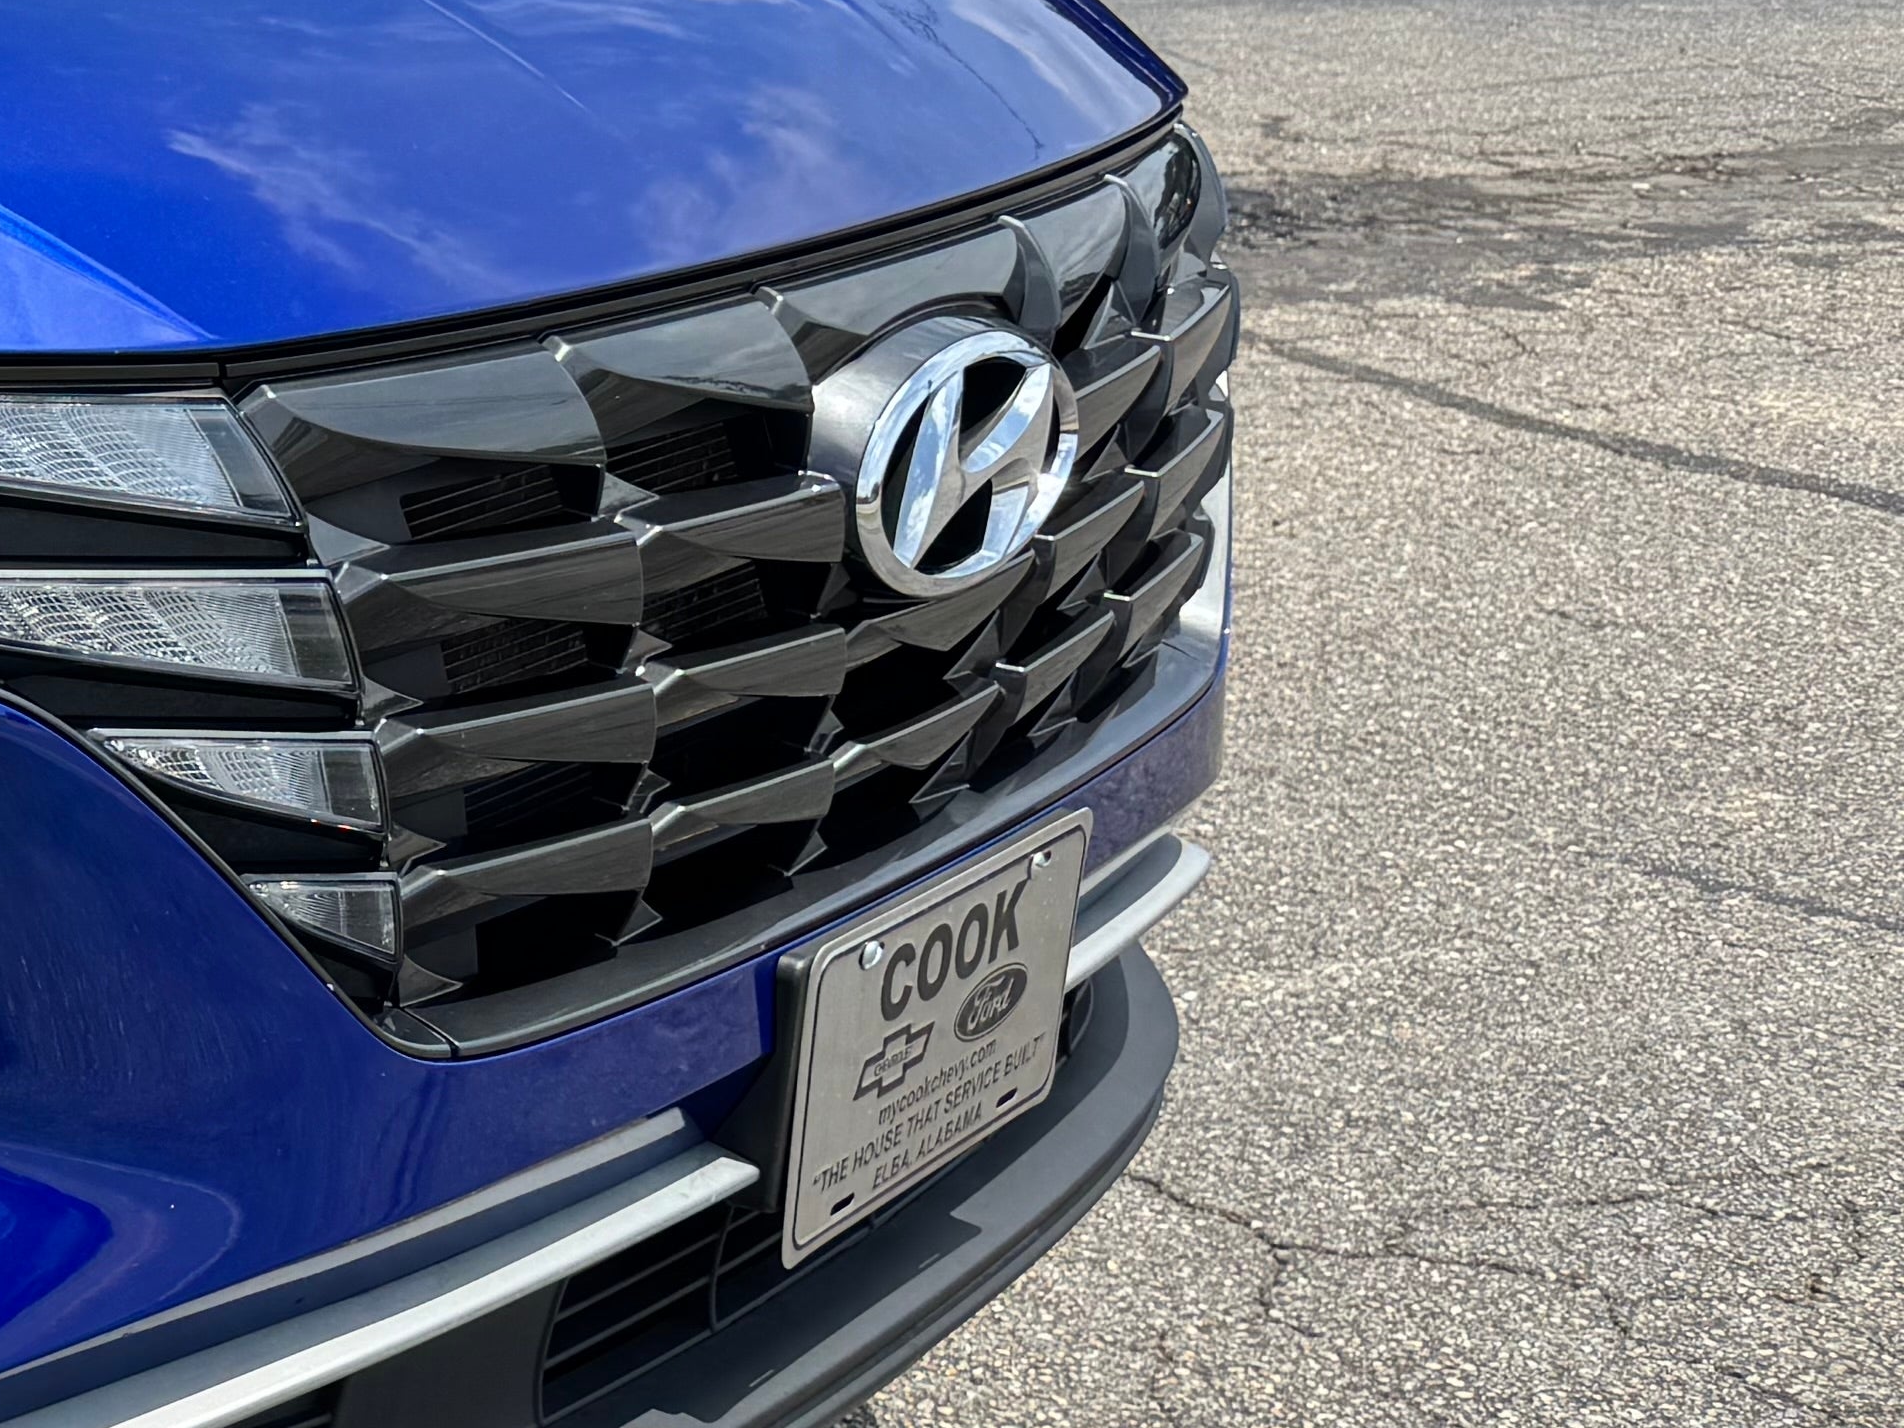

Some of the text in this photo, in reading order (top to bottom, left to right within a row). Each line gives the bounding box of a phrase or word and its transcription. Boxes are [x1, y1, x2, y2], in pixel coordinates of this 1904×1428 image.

[880, 878, 1030, 1021] COOK
[966, 974, 1015, 1032] Ford
[852, 1123, 903, 1172] HOUSE
[907, 1098, 942, 1137] THAT
[944, 1060, 1001, 1114] SERVICE
[878, 1038, 997, 1125] mycookchevy.com
[915, 1100, 982, 1161] ALABAMA
